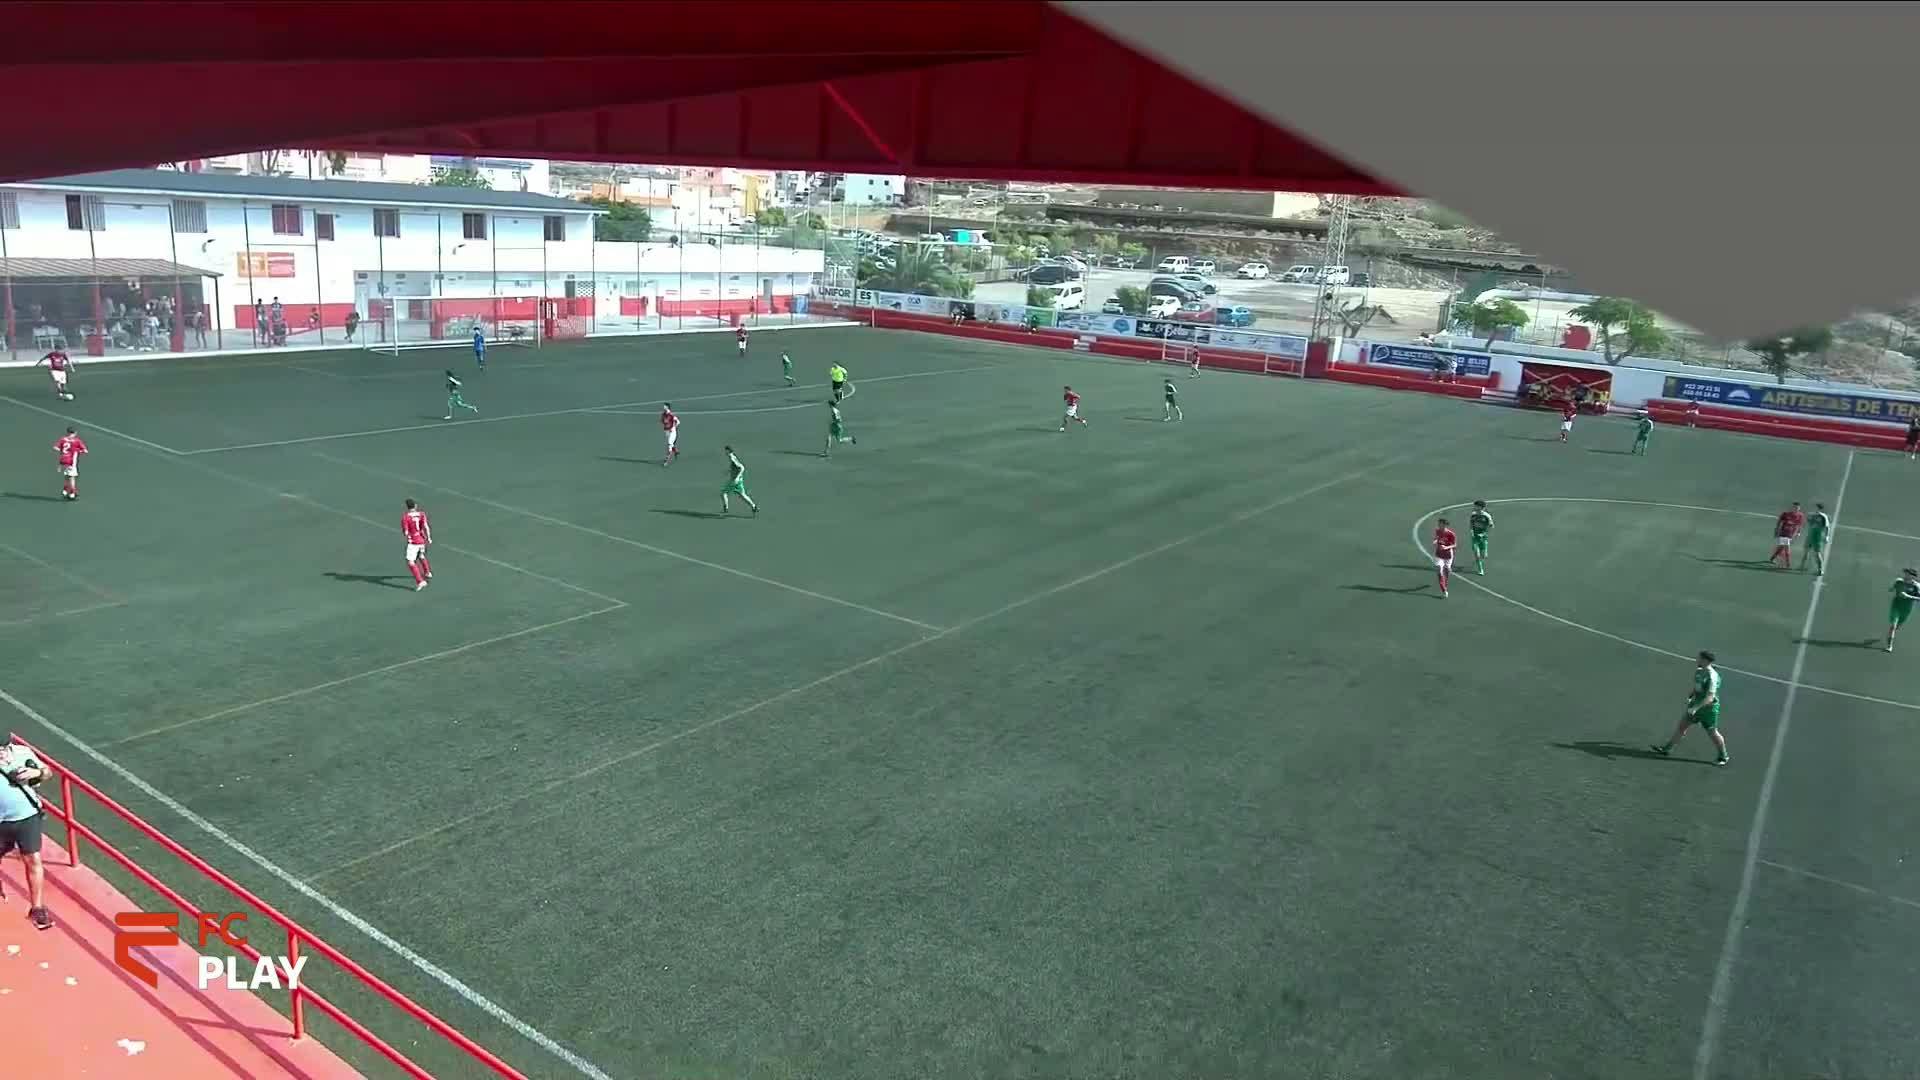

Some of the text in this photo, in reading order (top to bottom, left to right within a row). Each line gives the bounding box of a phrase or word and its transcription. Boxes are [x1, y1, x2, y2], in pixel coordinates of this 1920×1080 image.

[819, 286, 872, 300] UNIFORES
[1762, 391, 1850, 410] ARTISAS
[1856, 399, 1881, 414] DE
[63, 442, 71, 454] 2
